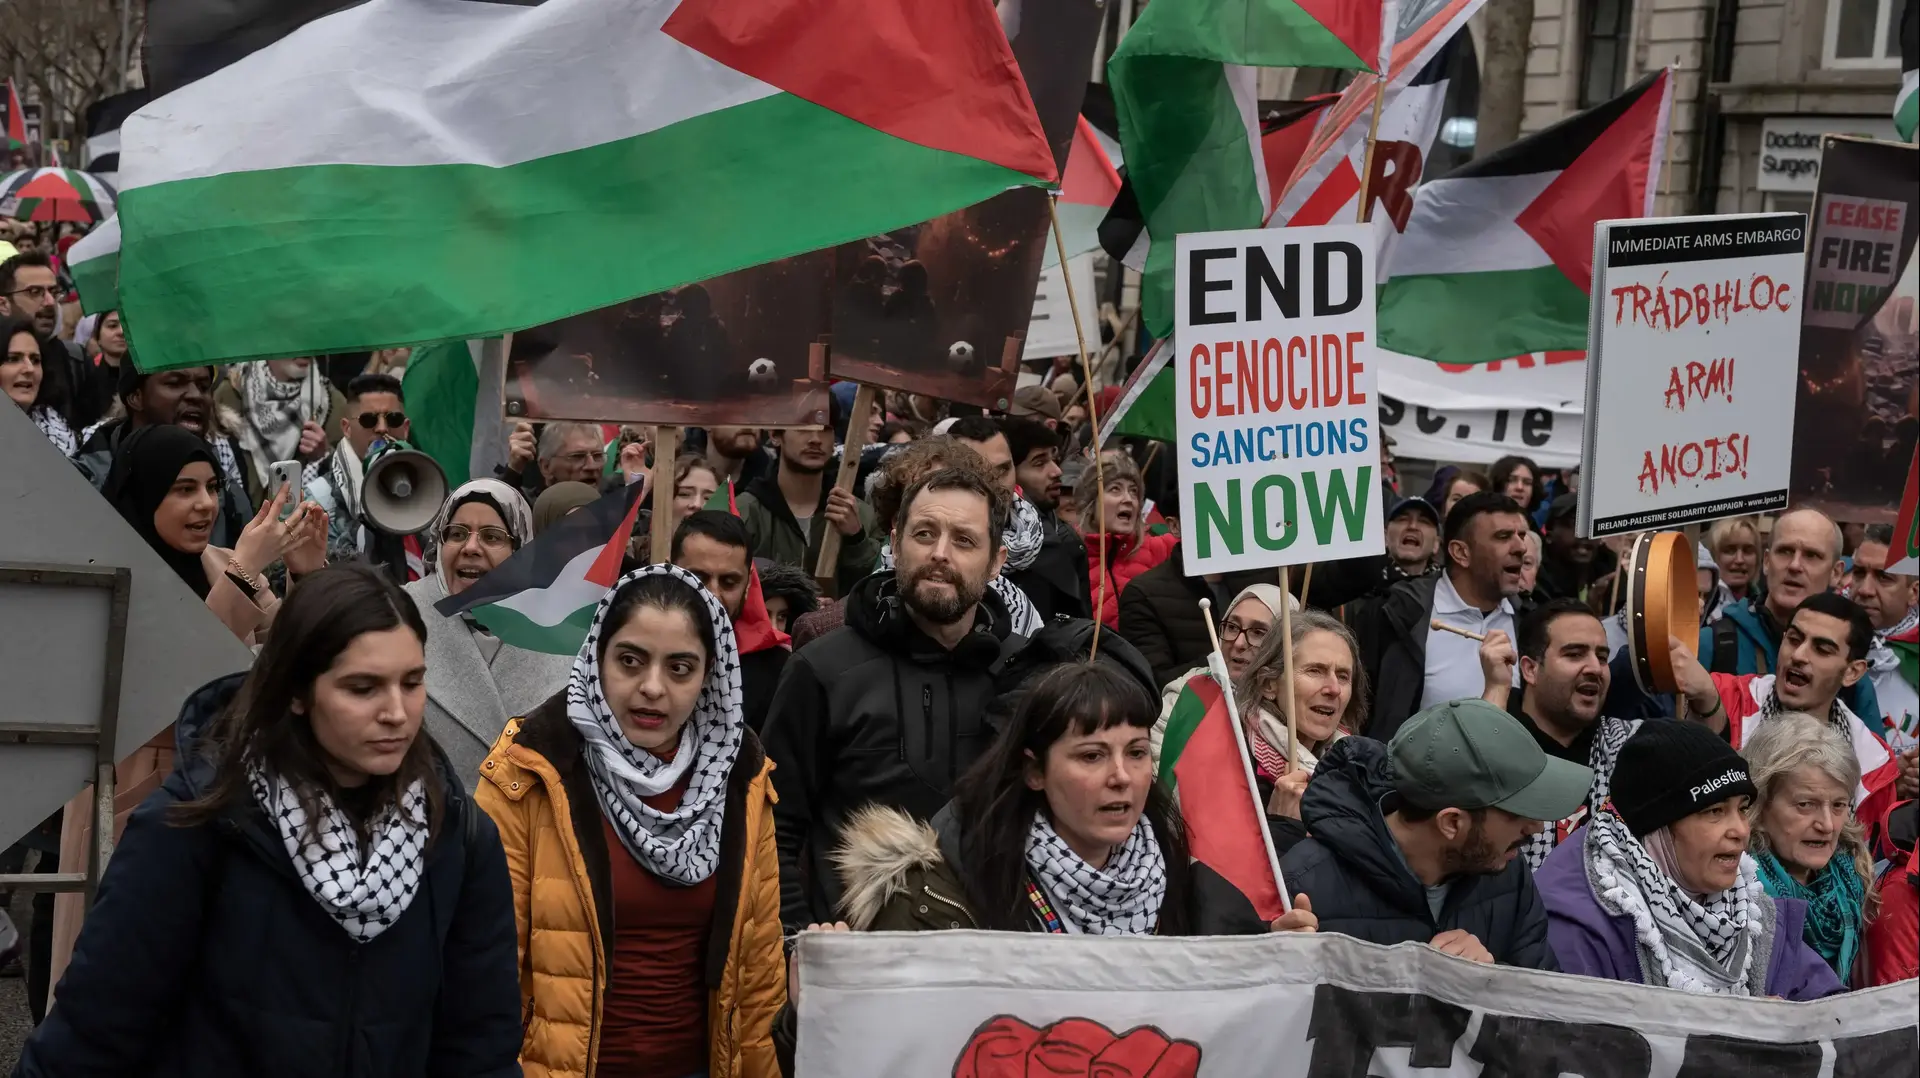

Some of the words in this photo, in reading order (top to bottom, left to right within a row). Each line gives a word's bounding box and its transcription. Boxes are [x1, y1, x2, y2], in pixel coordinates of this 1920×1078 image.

[1612, 235, 1690, 254] IMMEDIATE
[1694, 232, 1732, 248] ARMS
[1736, 228, 1801, 245] EMBARGO
[1826, 202, 1900, 231] CEASE
[1819, 236, 1894, 273] FIRE
[1189, 241, 1363, 326] END
[1190, 332, 1366, 419] GENOCIDE
[1664, 357, 1735, 412] ARM!
[1191, 417, 1368, 468] SANCTIONS
[1637, 433, 1749, 495] ANOIS!
[1193, 465, 1372, 559] NOW
[1597, 512, 1667, 531] IRELAND-PALESTINE
[1668, 506, 1707, 520] SOLIDARITY
[1707, 500, 1744, 513] CAMPAIGN
[1748, 494, 1785, 506] www.ipsc.ie
[1689, 768, 1748, 802] Palestine
